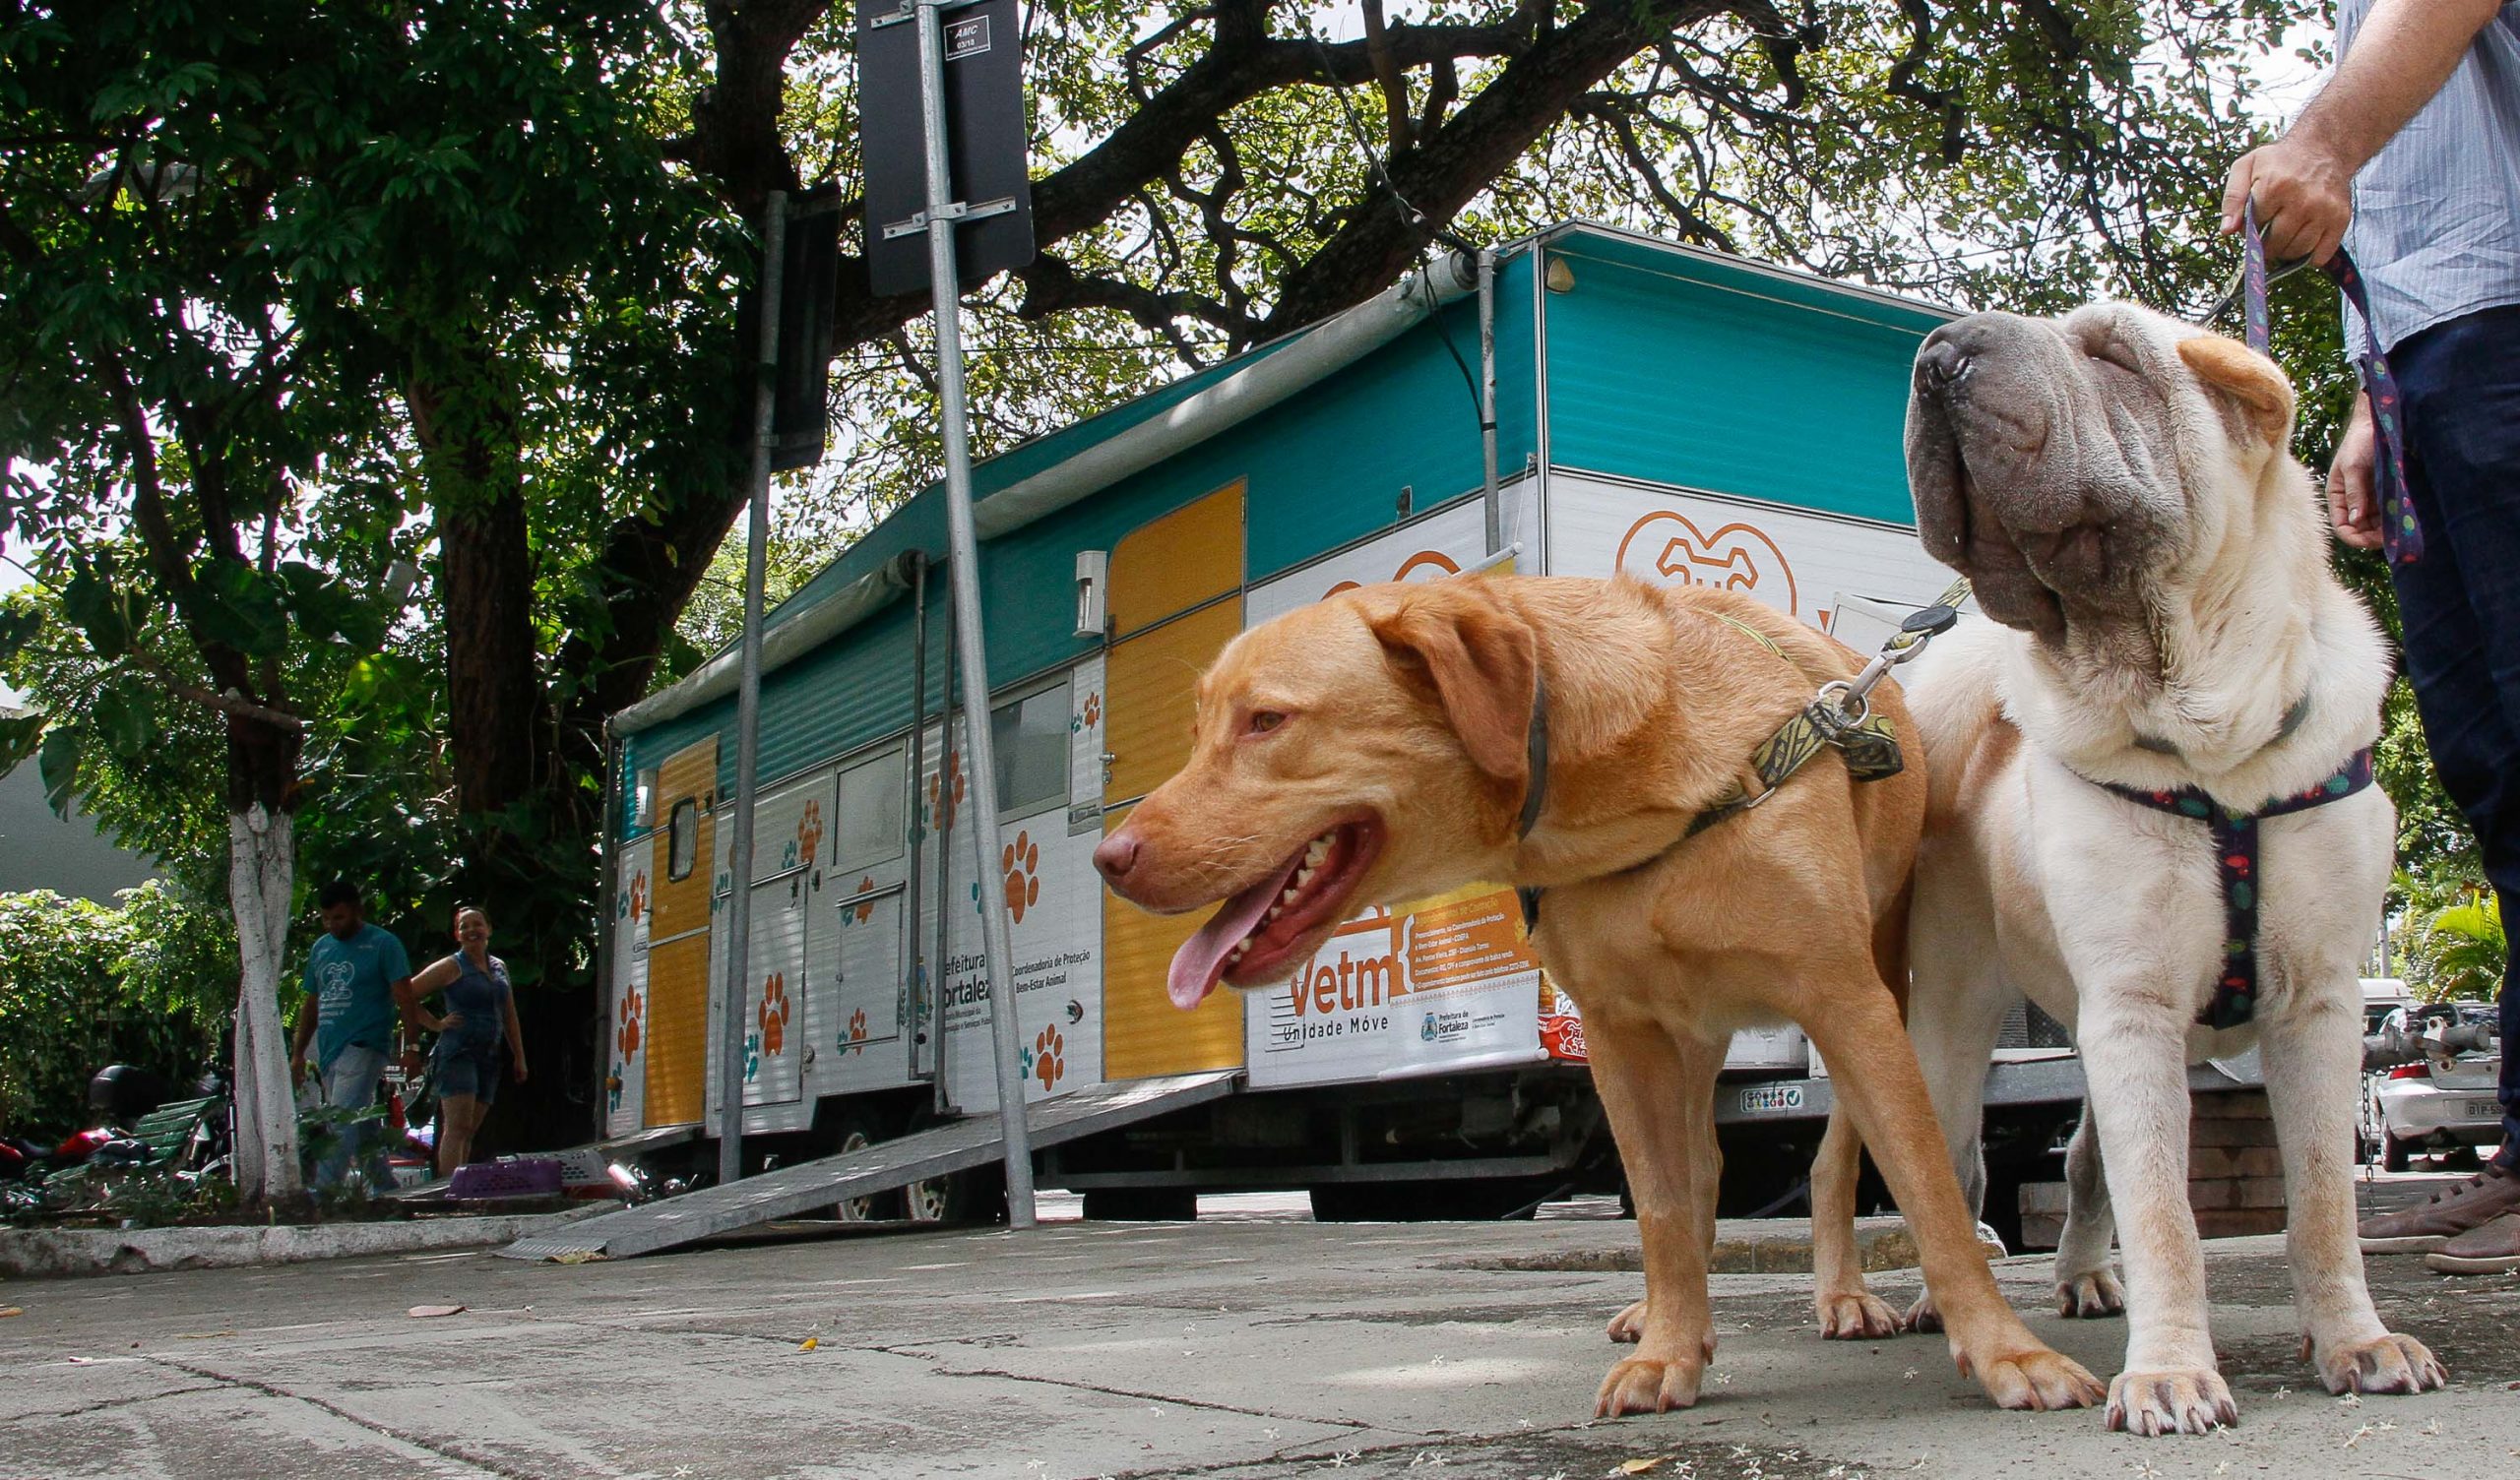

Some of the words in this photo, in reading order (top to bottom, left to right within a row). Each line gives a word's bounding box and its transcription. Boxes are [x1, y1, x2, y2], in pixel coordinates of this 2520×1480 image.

[955, 25, 978, 38] AMC
[946, 955, 984, 975] efeitura
[1054, 956, 1062, 966] de
[1063, 950, 1090, 966] Proteção
[945, 974, 990, 1008] ortalez
[1016, 978, 1044, 994] Bem-Estar
[1045, 971, 1066, 987] Animal
[1291, 951, 1390, 1017] Vetm
[1284, 1020, 1343, 1040] Unidade
[1351, 1016, 1388, 1033] Móve
[1438, 1021, 1469, 1034] Fortaleza
